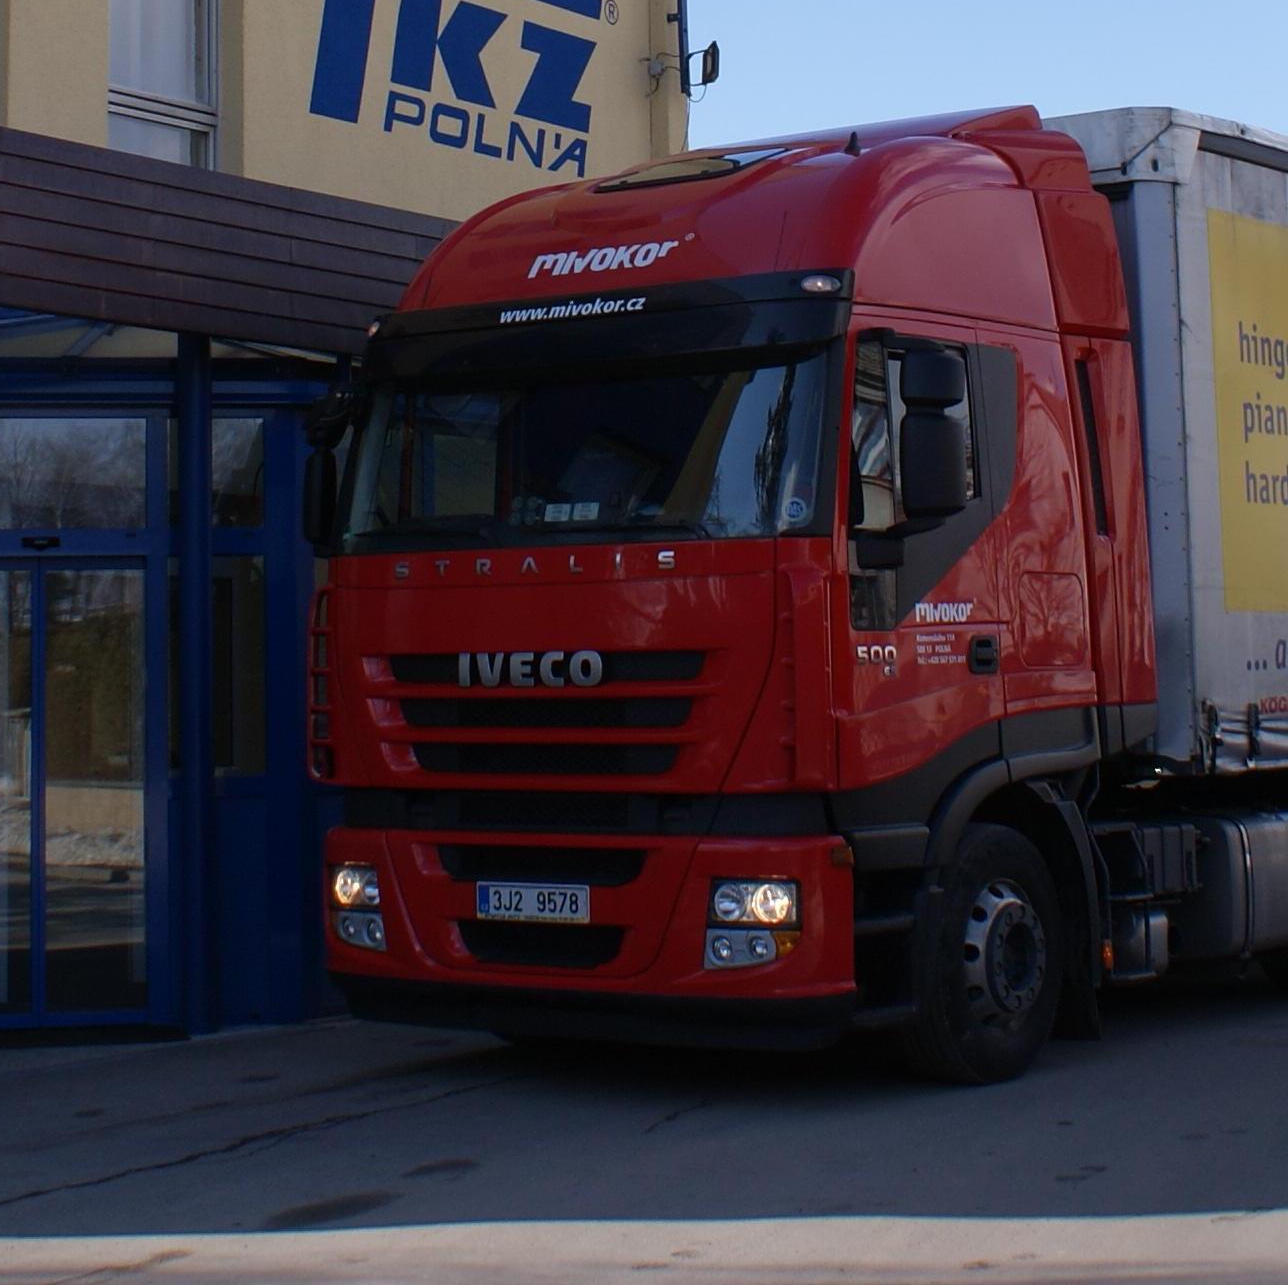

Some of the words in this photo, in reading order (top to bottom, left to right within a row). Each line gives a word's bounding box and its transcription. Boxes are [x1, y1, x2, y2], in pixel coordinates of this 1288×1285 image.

[499, 296, 647, 324] www.mivokor.cz
[394, 550, 676, 580] STRALIS
[458, 650, 603, 687] IVECO
[856, 645, 897, 666] 500
[493, 890, 523, 912] 3J2
[536, 891, 579, 914] 9578
